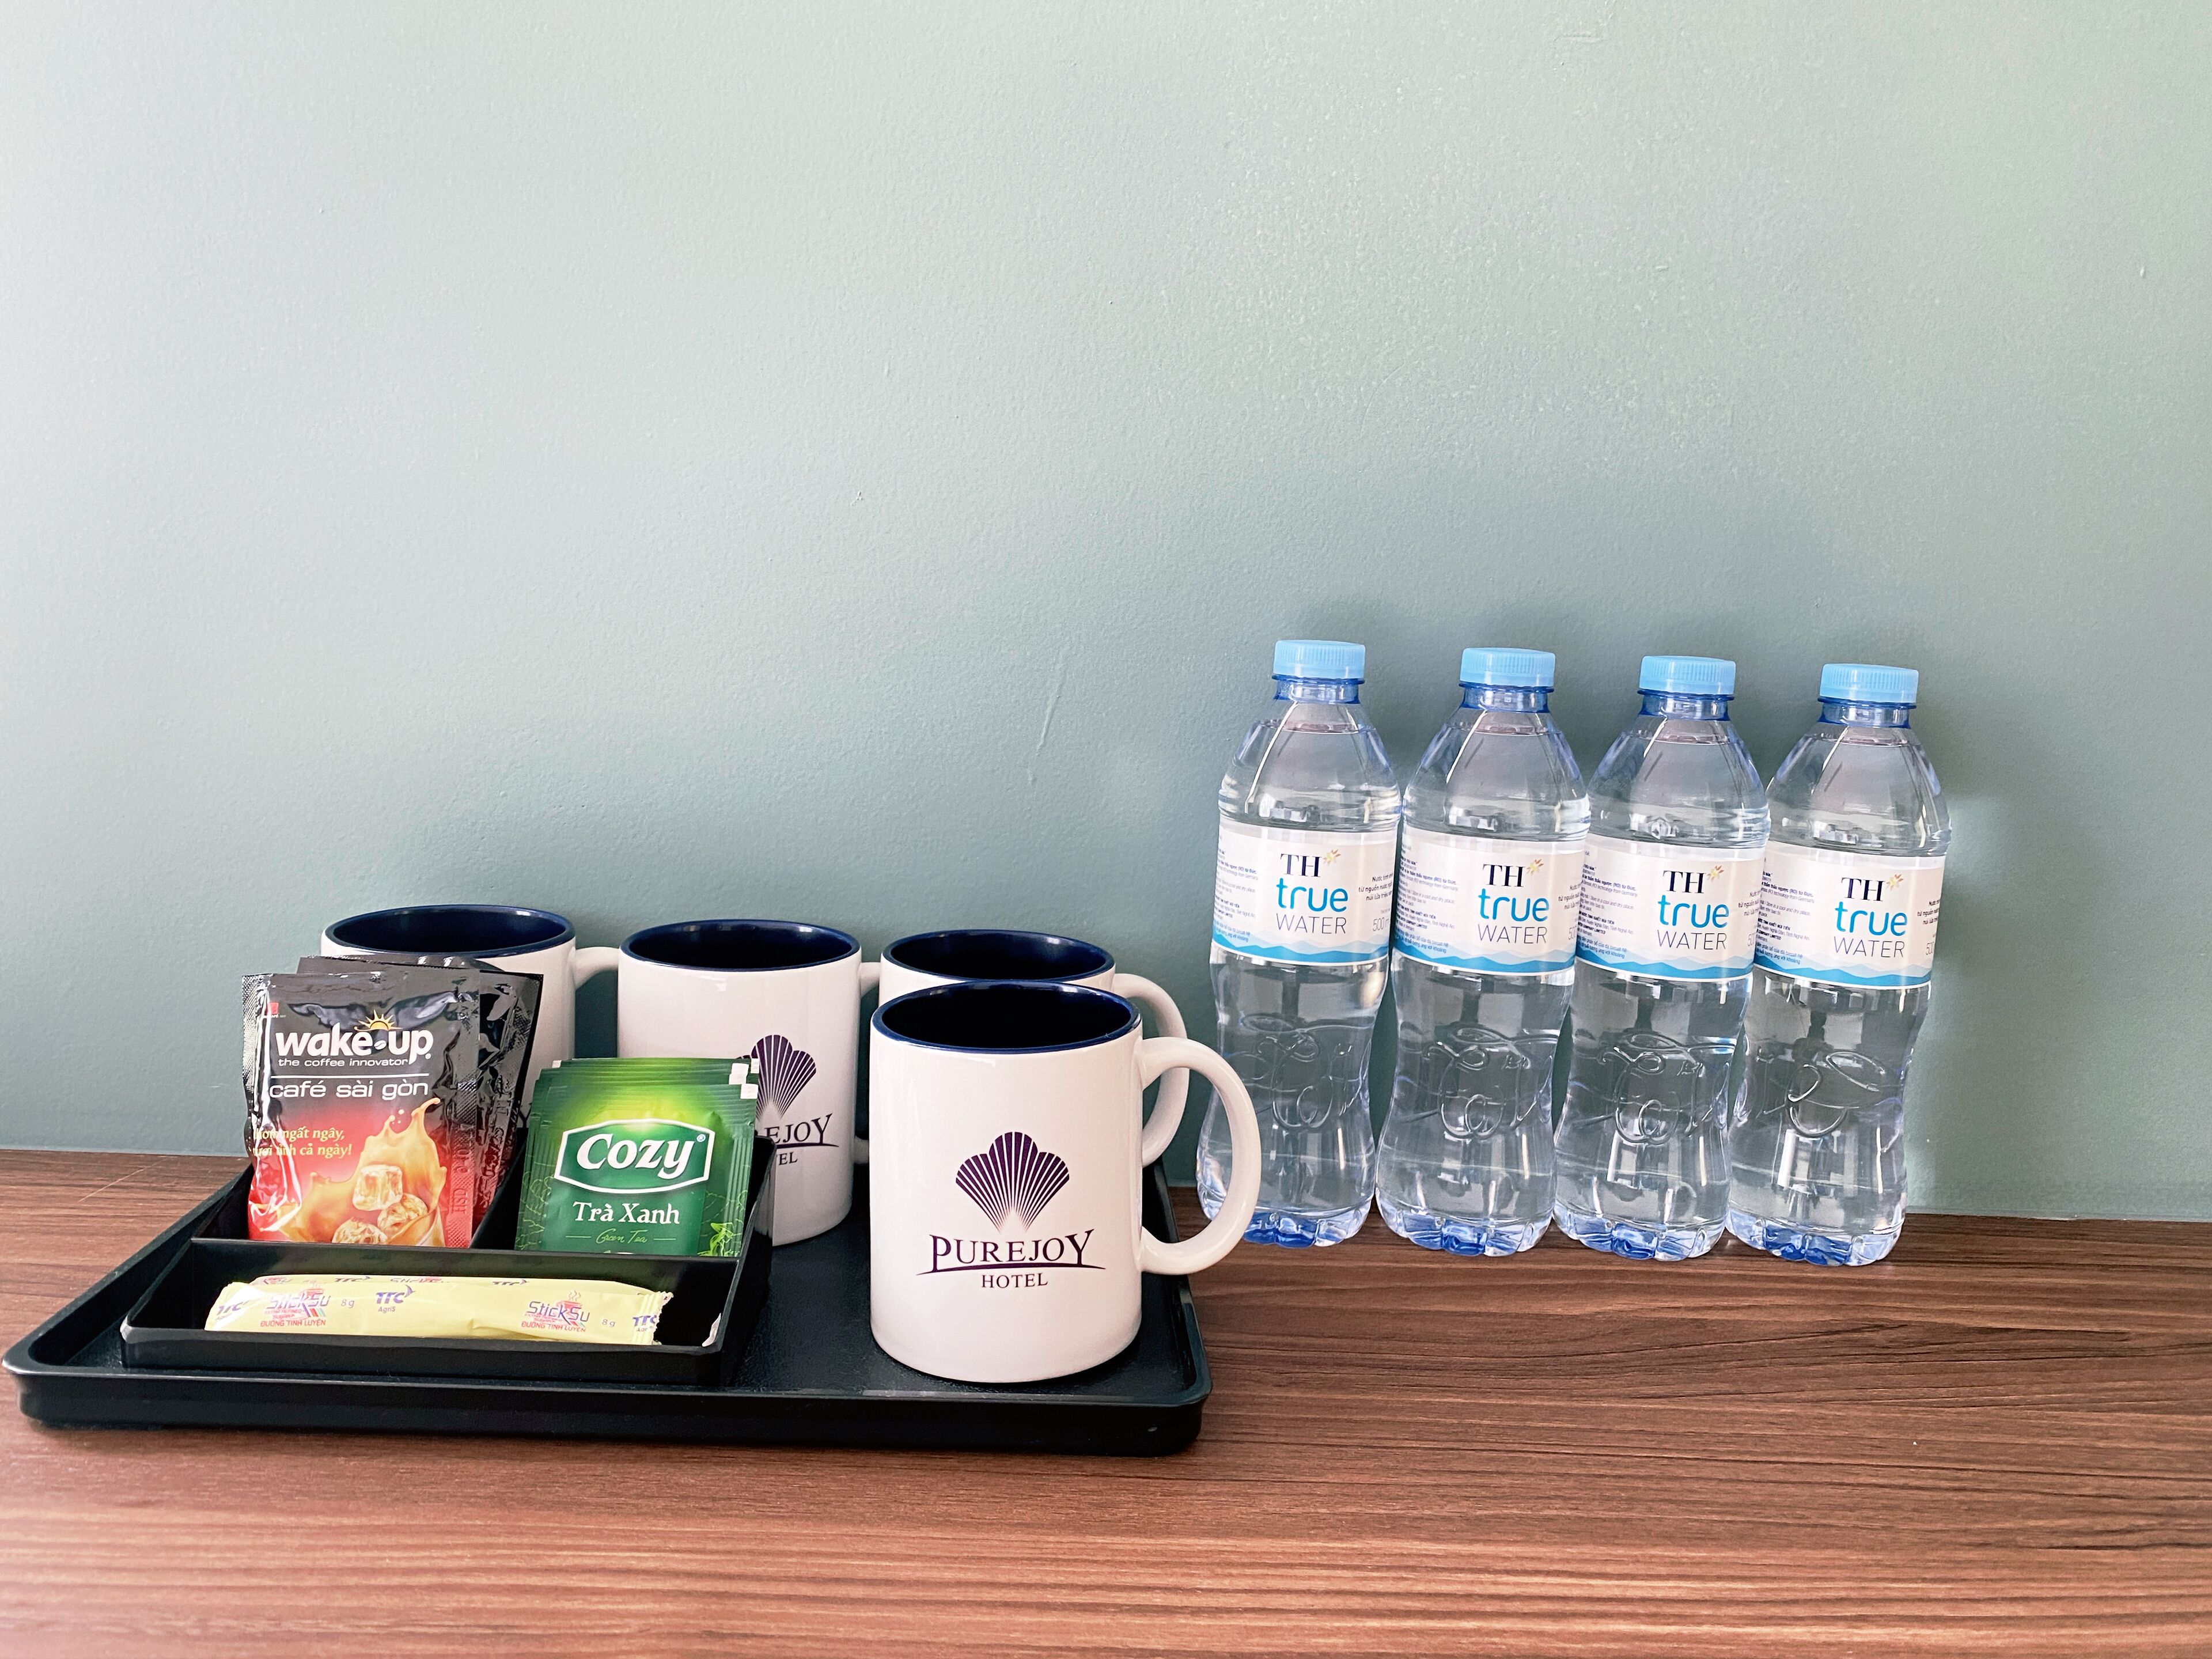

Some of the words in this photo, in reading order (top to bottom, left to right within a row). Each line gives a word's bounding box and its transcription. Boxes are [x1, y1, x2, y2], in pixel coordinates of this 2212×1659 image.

[1280, 853, 1322, 877] TH
[1482, 863, 1526, 888] TH
[1662, 870, 1707, 894] TH
[1841, 877, 1886, 902] TH
[1276, 878, 1349, 912] true
[1478, 888, 1550, 922] true
[1657, 895, 1729, 928] true
[1835, 902, 1907, 937] true
[1276, 913, 1347, 934] WATER
[1478, 923, 1548, 944] WATER
[1657, 929, 1727, 950] WATER
[1834, 936, 1905, 958] WATER
[278, 1058, 300, 1067] the
[304, 1058, 345, 1067] coffee
[349, 1058, 408, 1067] innovator
[269, 1080, 326, 1099] café
[336, 1080, 373, 1098] sài
[382, 1081, 428, 1101] gòn
[313, 1127, 345, 1142] ngây,
[764, 1113, 833, 1143] EJOY
[300, 1143, 313, 1156] cả
[317, 1143, 352, 1158] ngày!
[576, 1133, 695, 1180] Cozy
[572, 1202, 613, 1222] Trà
[622, 1203, 680, 1225] Xanh
[627, 1229, 648, 1244] Tea
[929, 1229, 1094, 1271] PUREJOY
[981, 1273, 1048, 1288] HOTEL
[376, 1291, 405, 1304] TTC
